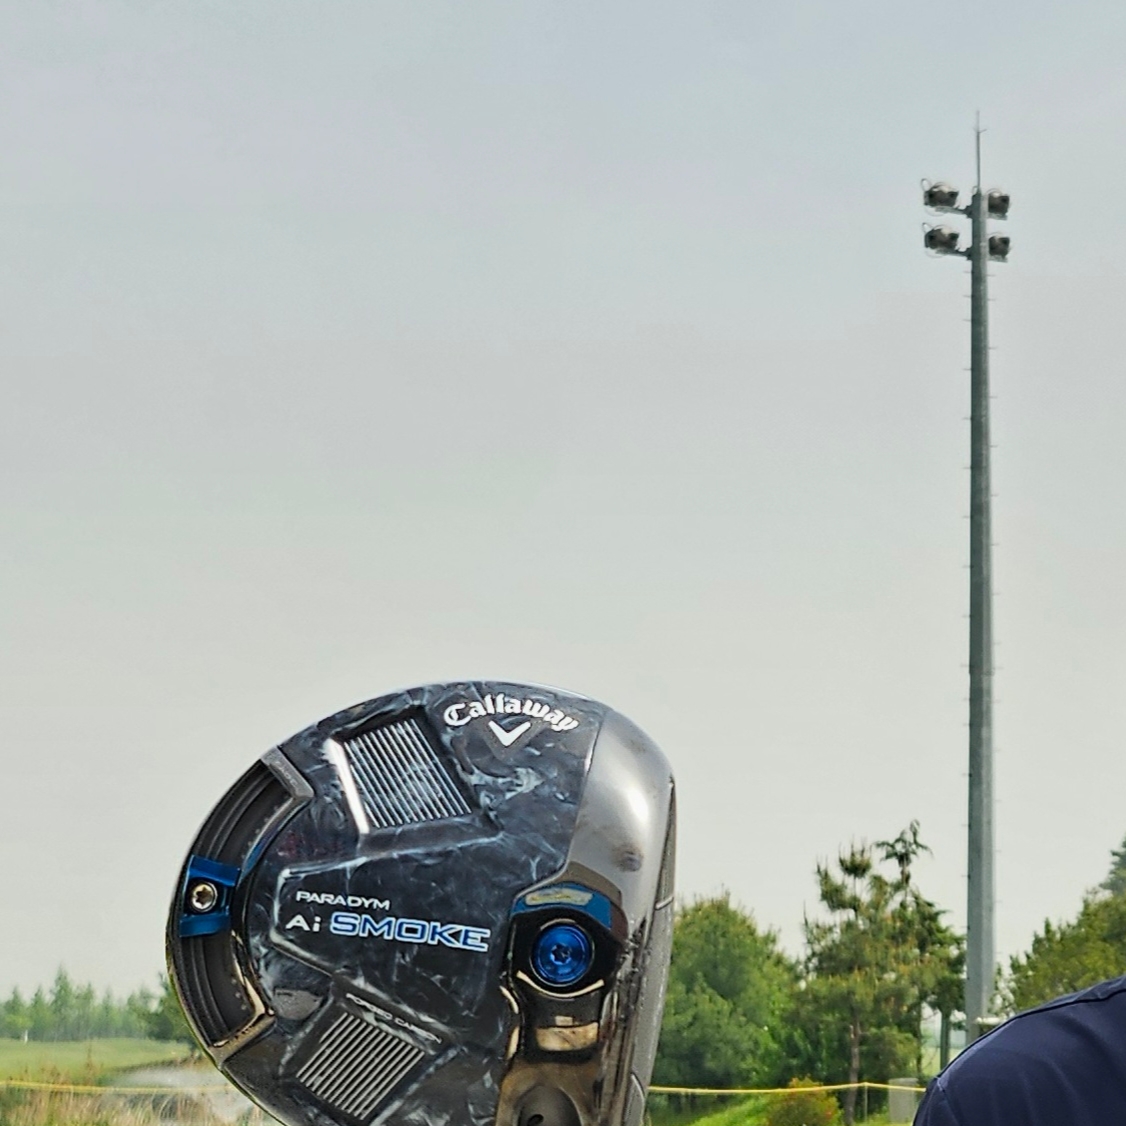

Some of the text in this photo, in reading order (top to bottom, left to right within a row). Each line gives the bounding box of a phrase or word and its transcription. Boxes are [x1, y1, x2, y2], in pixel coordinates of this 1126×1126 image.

[443, 693, 579, 732] Callaway
[296, 890, 391, 911] PARADYM
[285, 911, 491, 953] Ai SMOKE
